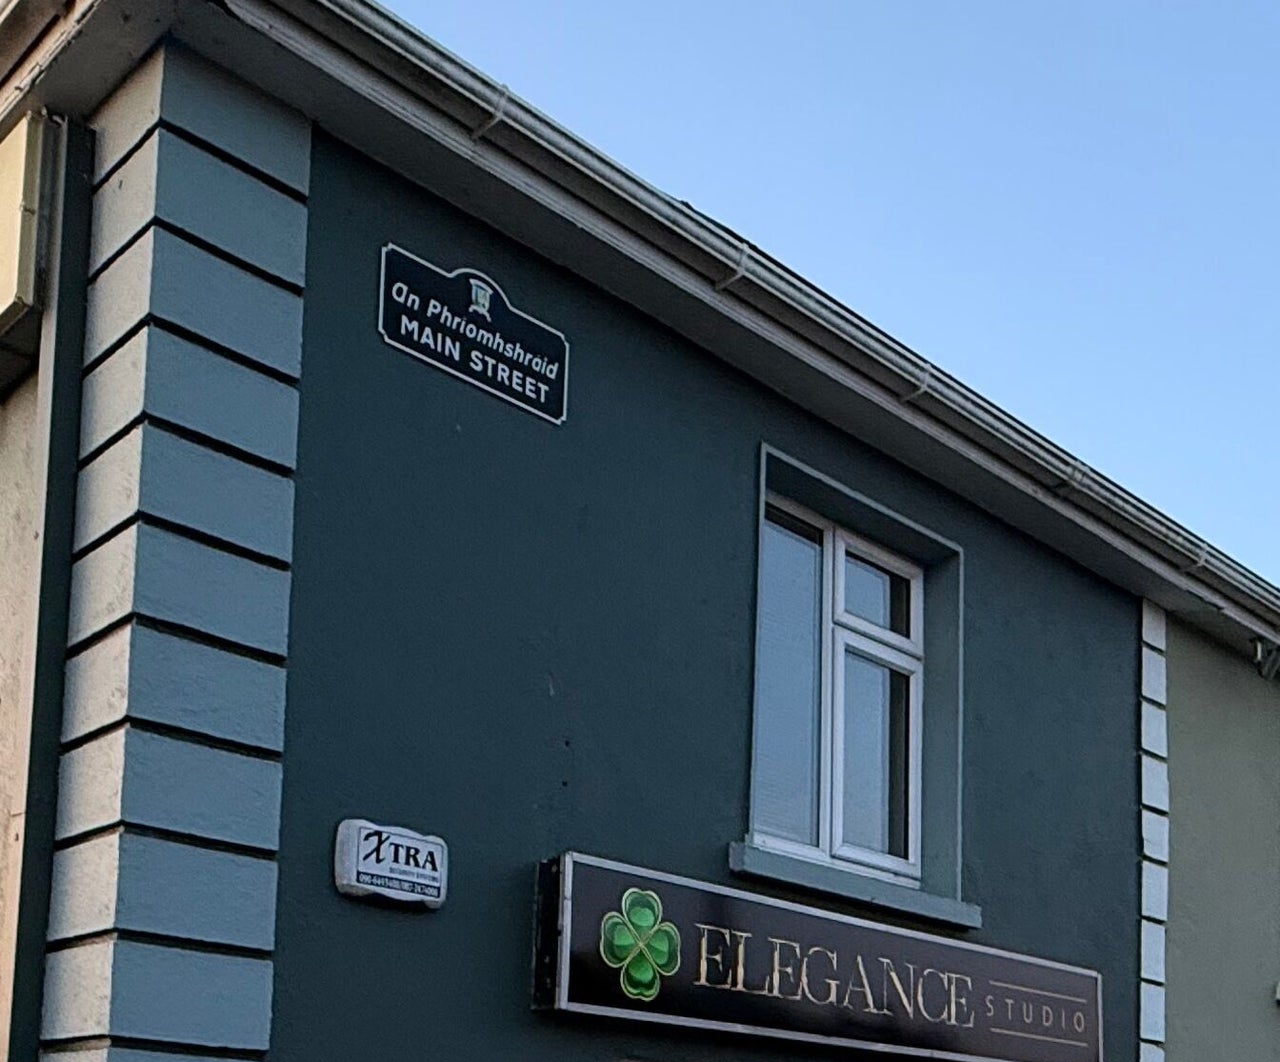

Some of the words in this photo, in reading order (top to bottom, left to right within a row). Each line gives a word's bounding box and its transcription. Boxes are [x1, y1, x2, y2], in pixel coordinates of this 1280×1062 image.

[401, 315, 460, 361] MAIN
[469, 350, 549, 403] STREET
[363, 830, 438, 872] XTRA
[693, 923, 974, 1028] ELEGANCE
[985, 995, 1085, 1033] STUDIO
